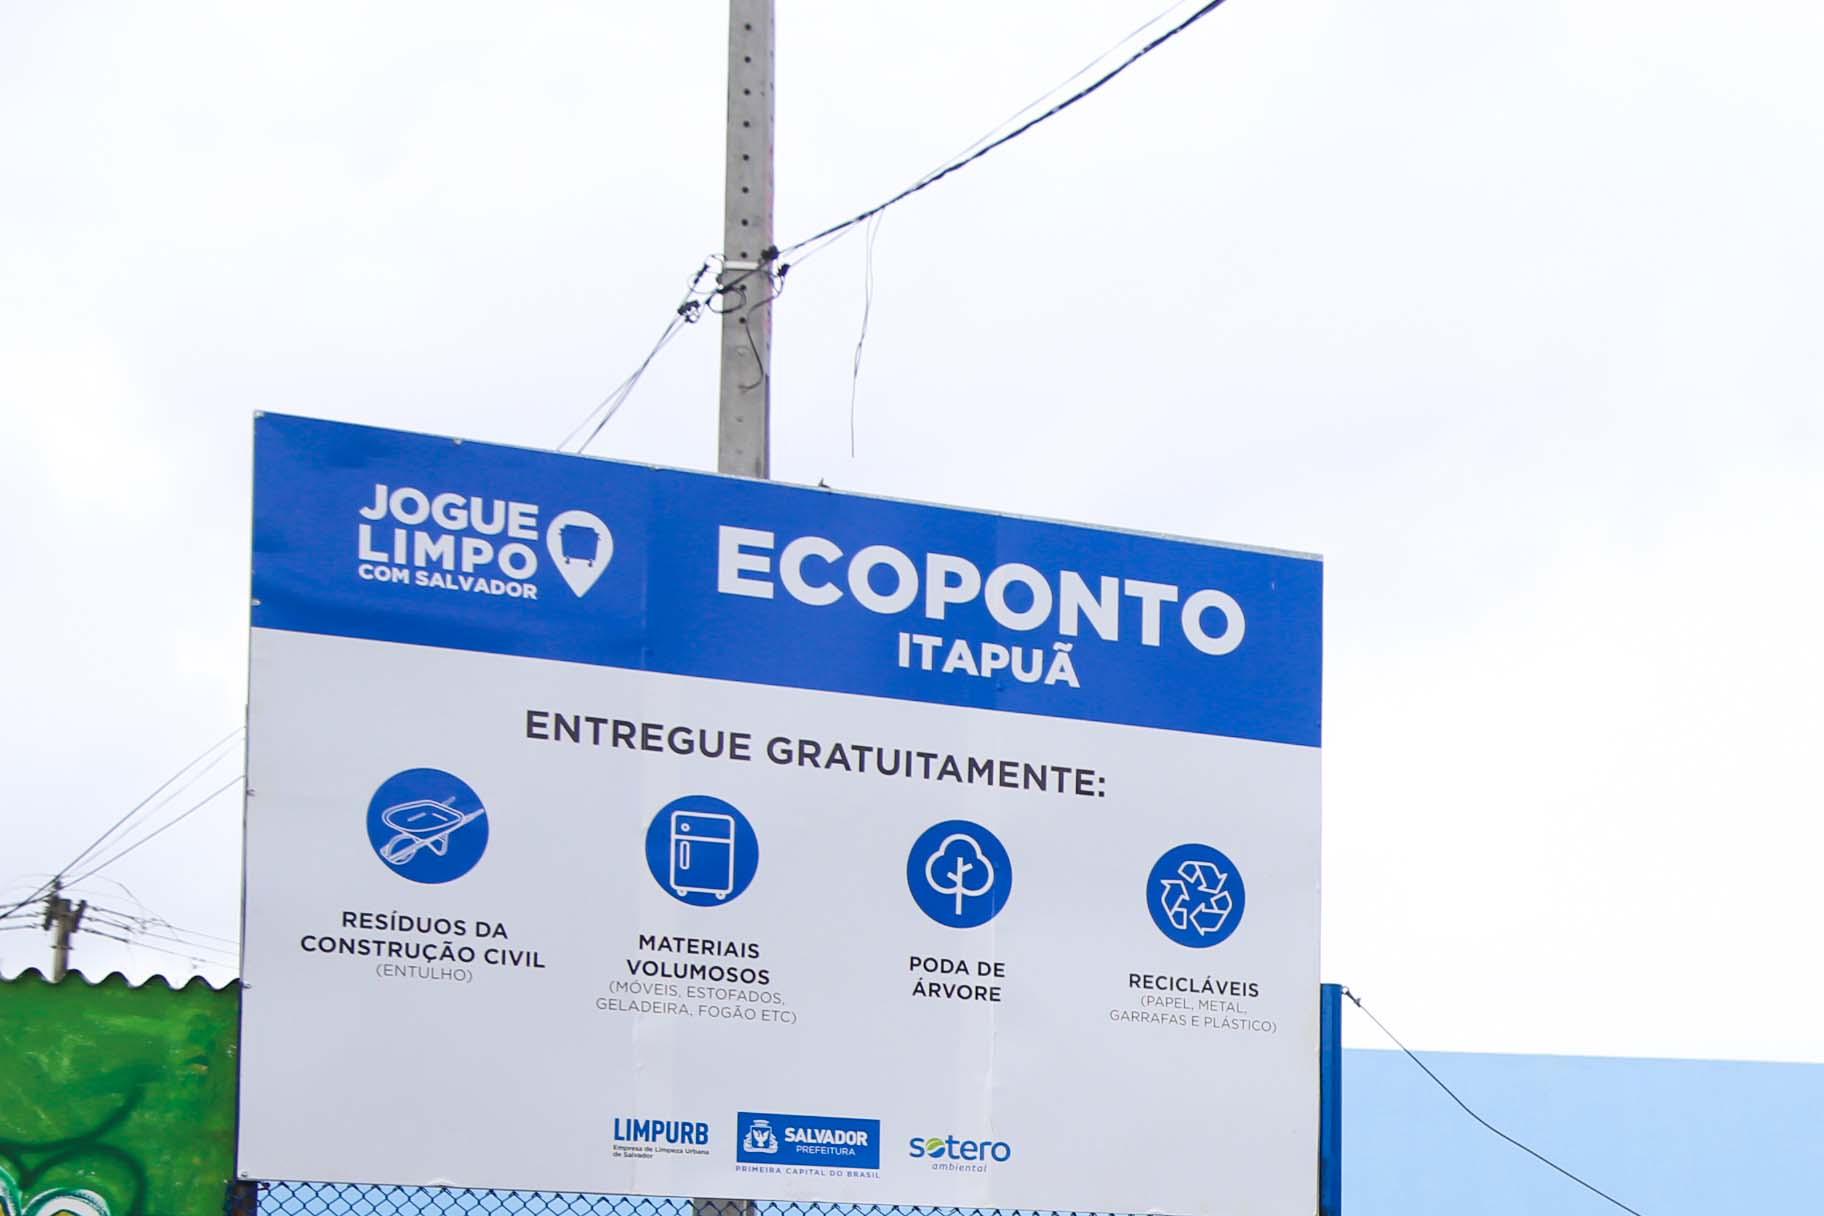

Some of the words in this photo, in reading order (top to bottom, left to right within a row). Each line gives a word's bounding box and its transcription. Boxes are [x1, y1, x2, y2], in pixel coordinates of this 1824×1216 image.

[359, 483, 539, 541] JOGUE
[358, 523, 538, 580] LIMPO
[358, 563, 410, 585] COM
[415, 570, 538, 600] SALVADOR
[716, 524, 1246, 656] ECOPONTO
[897, 632, 1081, 689] ITAPUÃ
[526, 709, 752, 762] ENTREGUE
[766, 735, 1105, 798] GRATUITAMENTE:
[341, 910, 467, 936] RESÍDUOS
[475, 921, 508, 940] DA
[300, 935, 476, 963] CONSTRUÇÃO
[484, 948, 546, 968] CIVIL
[639, 934, 760, 959] MATERIAIS
[375, 963, 473, 984] (ENTULHO)
[626, 959, 770, 985] VOLUMOSOS
[909, 955, 970, 976] PODA
[977, 960, 1006, 979] DE
[608, 979, 681, 998] (MÓVEIS,
[687, 986, 785, 1006] ESTOFADOS,
[911, 976, 1002, 1003] ÁRVORE
[1129, 973, 1259, 998] RECICLÁVEIS
[595, 997, 693, 1017] GELADEIRA,
[699, 1004, 757, 1021] FOGÃO
[761, 1009, 797, 1025] ETC)
[1140, 995, 1194, 1011] (PAPEL,
[1198, 999, 1248, 1015] METAL,
[1109, 1009, 1187, 1027] GARRAFAS
[1191, 1015, 1200, 1027] E
[1204, 1016, 1277, 1034] PLÁSTICO)
[614, 1118, 709, 1145] LIMPURB
[784, 1127, 868, 1146] SALVADOR
[612, 1144, 642, 1152] Empresa
[623, 1151, 653, 1159] Salvador
[796, 1145, 856, 1156] PREFEITURA
[909, 1134, 1011, 1163] sotero
[735, 1165, 782, 1175] PRIMEIRA
[785, 1168, 826, 1177] CAPITAL
[829, 1170, 843, 1178] DO
[847, 1170, 880, 1180] BRASIL
[931, 1160, 988, 1173] ambiental
